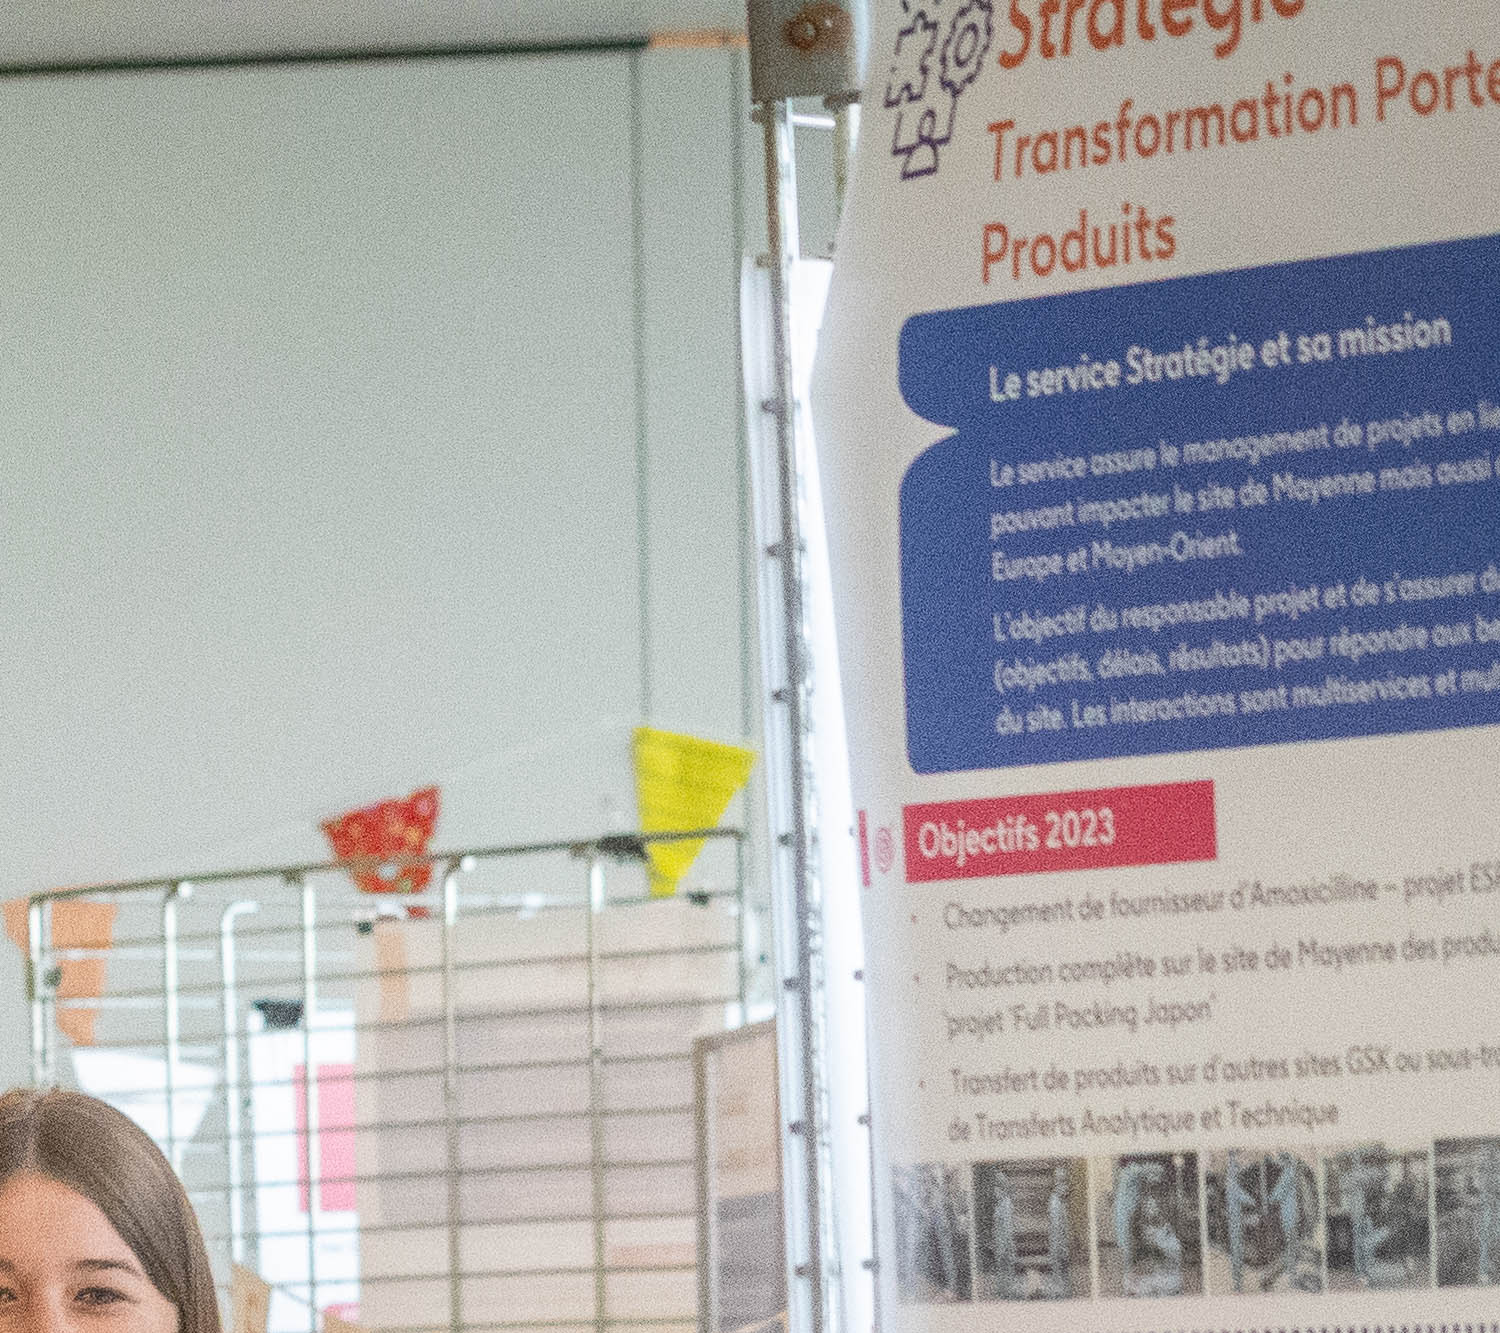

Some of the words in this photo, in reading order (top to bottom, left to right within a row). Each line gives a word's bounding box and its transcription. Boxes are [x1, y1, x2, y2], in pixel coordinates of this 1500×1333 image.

[986, 81, 1359, 182] Transformation
[981, 205, 1177, 285] Produits
[989, 365, 1023, 404] Le
[1025, 352, 1122, 399] service
[1125, 336, 1256, 386] Stratégie
[1259, 330, 1292, 369] et
[1296, 332, 1332, 365] sa
[1337, 317, 1452, 359] mission
[917, 814, 1040, 866] Objectifs
[1044, 806, 1117, 849] 2023
